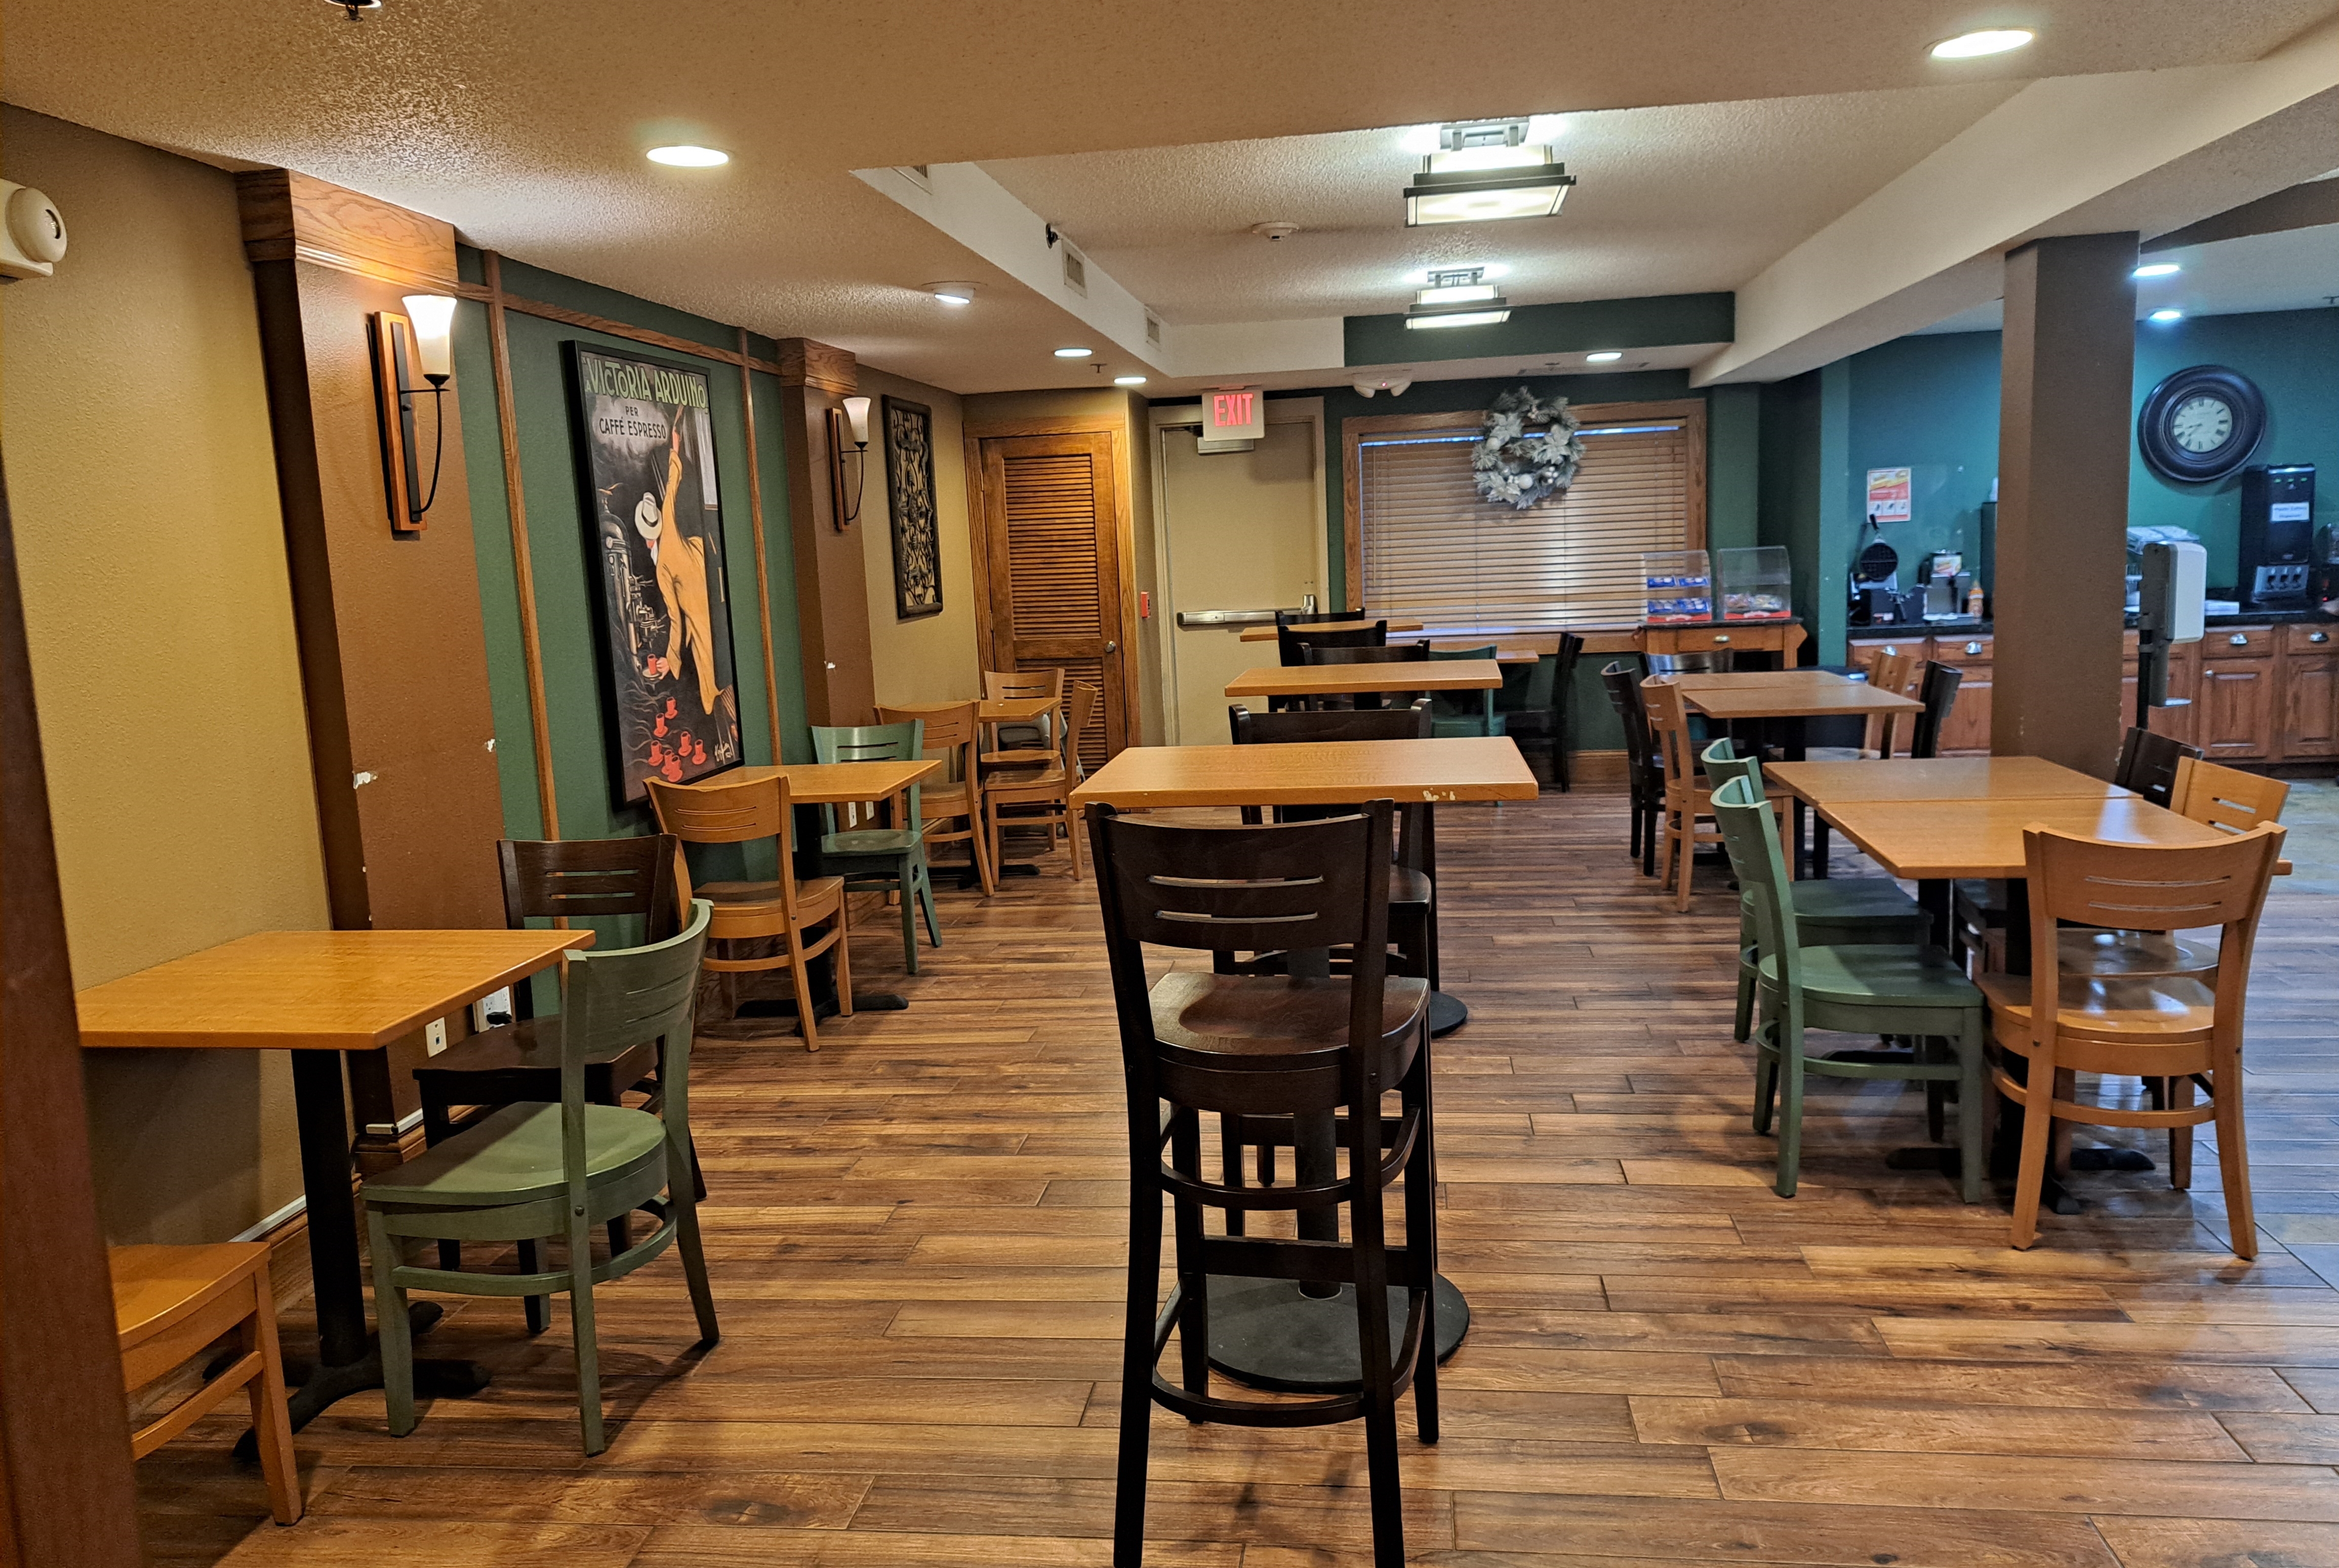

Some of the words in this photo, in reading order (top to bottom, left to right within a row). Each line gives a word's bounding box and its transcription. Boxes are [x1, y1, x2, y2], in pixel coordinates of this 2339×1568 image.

[625, 406, 638, 417] PER
[1214, 393, 1253, 426] EXIT
[599, 416, 625, 435] CAFFÉ
[627, 420, 666, 439] ESPRESSO
